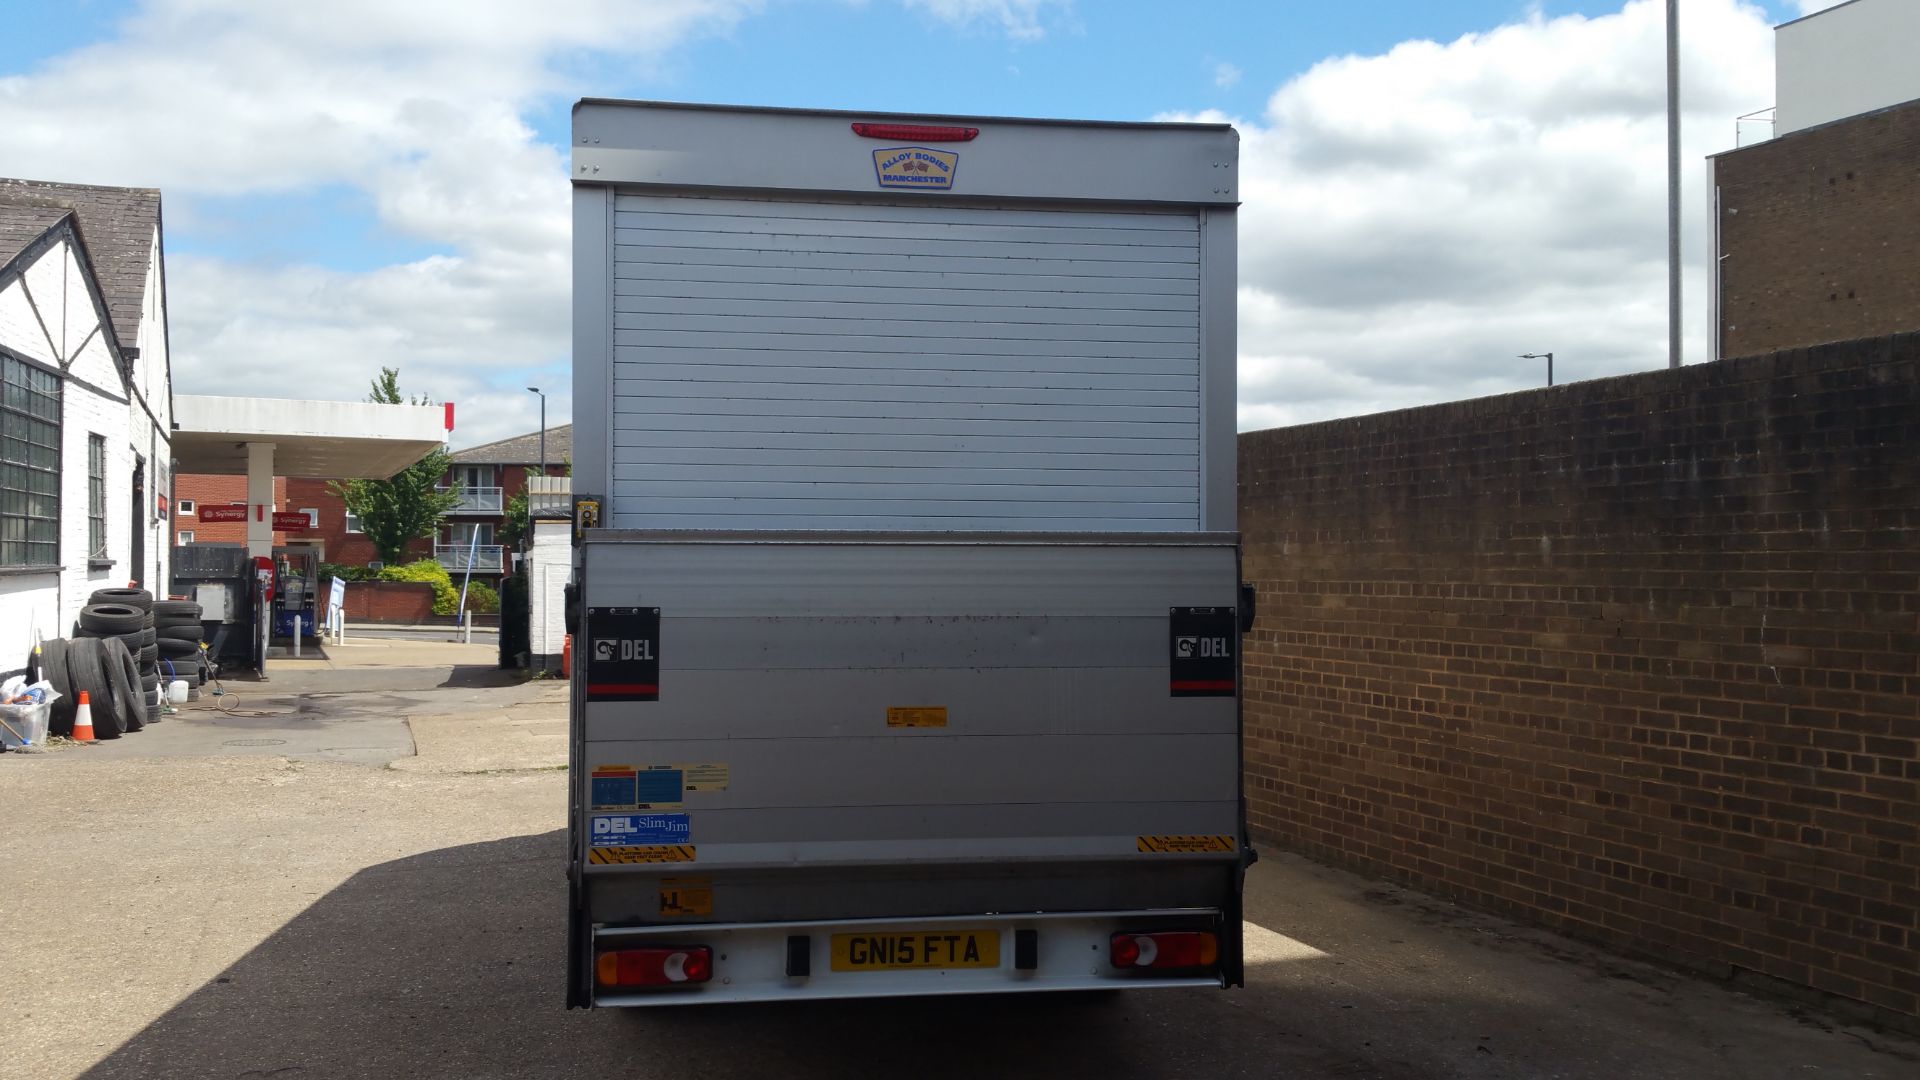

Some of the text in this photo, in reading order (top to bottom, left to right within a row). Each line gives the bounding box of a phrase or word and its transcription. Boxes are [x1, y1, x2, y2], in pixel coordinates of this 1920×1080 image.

[882, 152, 950, 172] ALLOY BODIES
[882, 174, 946, 183] MANCHESTER
[621, 640, 653, 660] DEL
[1200, 637, 1230, 657] DEL
[594, 817, 638, 834] DEL
[849, 935, 980, 965] GN15 FTA
